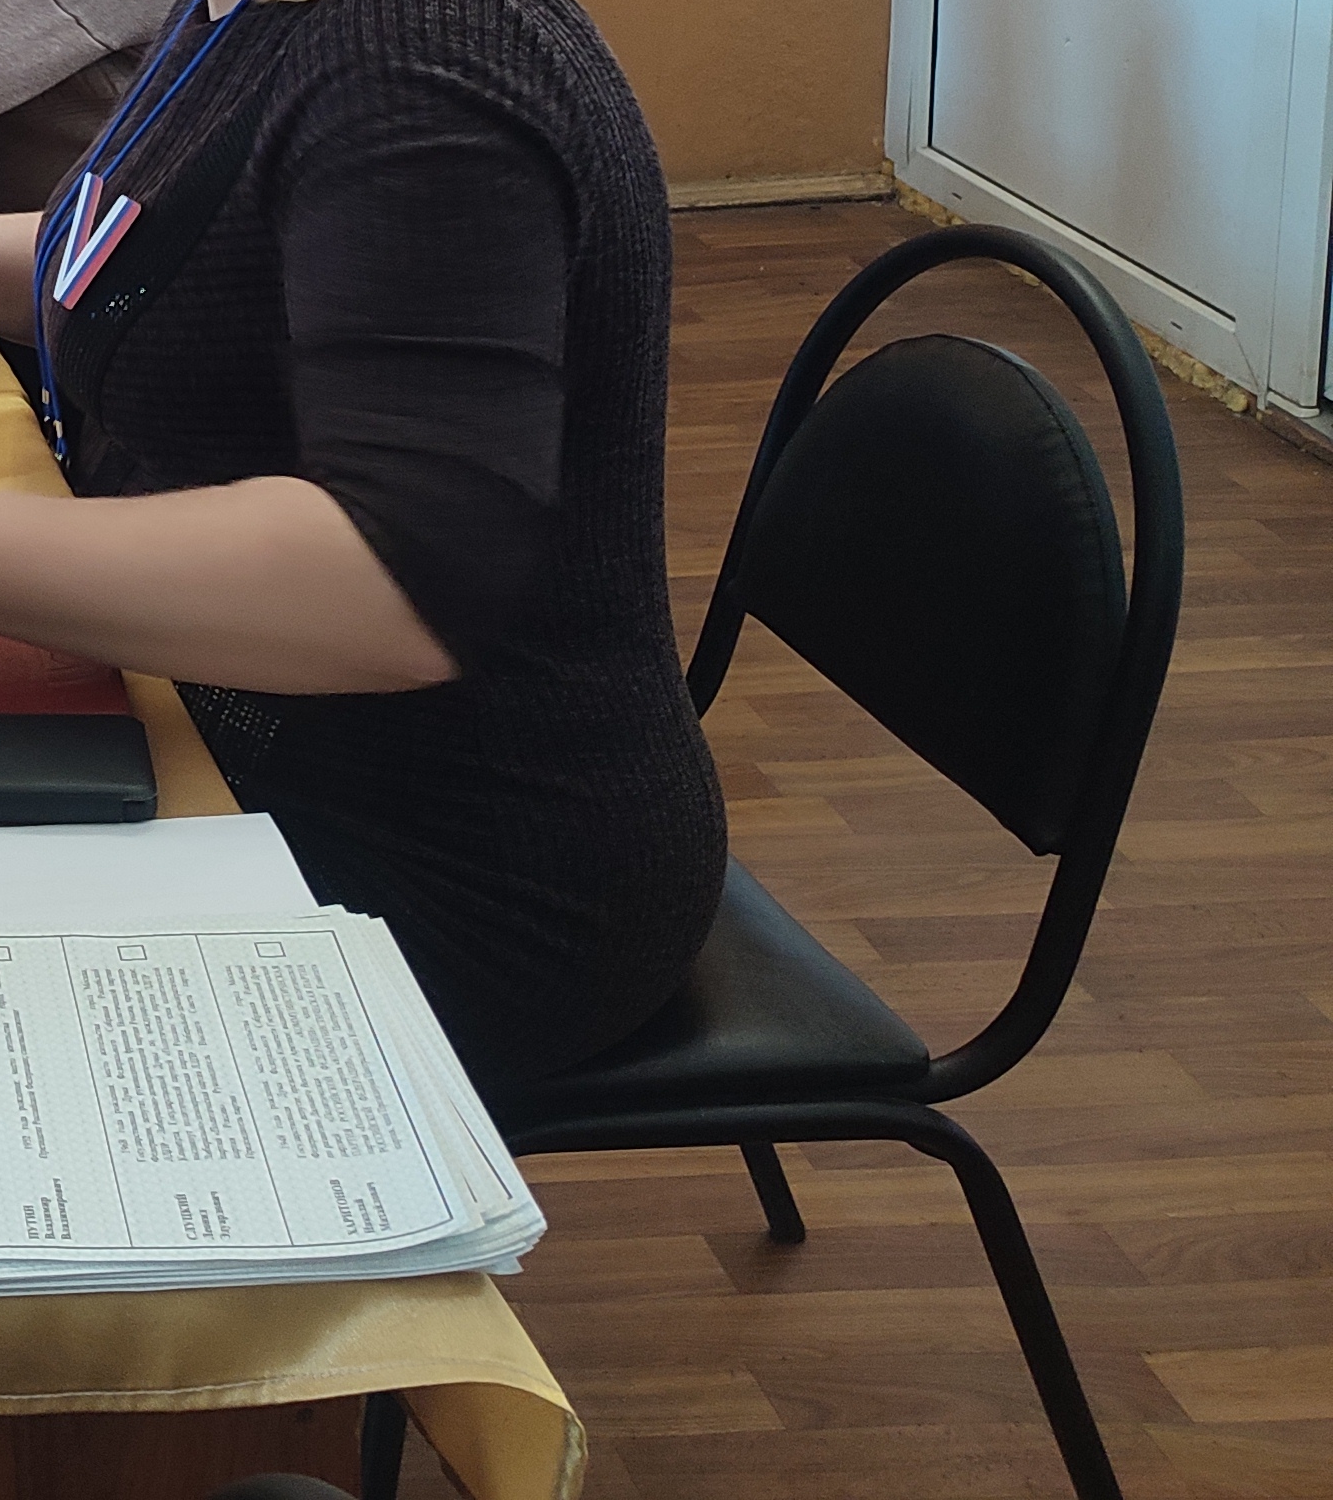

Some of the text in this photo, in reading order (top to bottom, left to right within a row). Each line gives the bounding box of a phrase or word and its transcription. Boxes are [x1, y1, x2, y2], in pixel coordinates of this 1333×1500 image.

[23, 1205, 39, 1240] ПУТИН
[39, 1197, 56, 1240] Владимир
[51, 1178, 72, 1240] Владимирович
[174, 1193, 198, 1240] СЛУЦКИЙ
[198, 1209, 215, 1240] Леонид
[209, 1191, 231, 1240] Эдуардович
[329, 1179, 359, 1236] ХАРИТОНОВ
[354, 1198, 375, 1234] Николай
[366, 1181, 393, 1232] Михайлович
